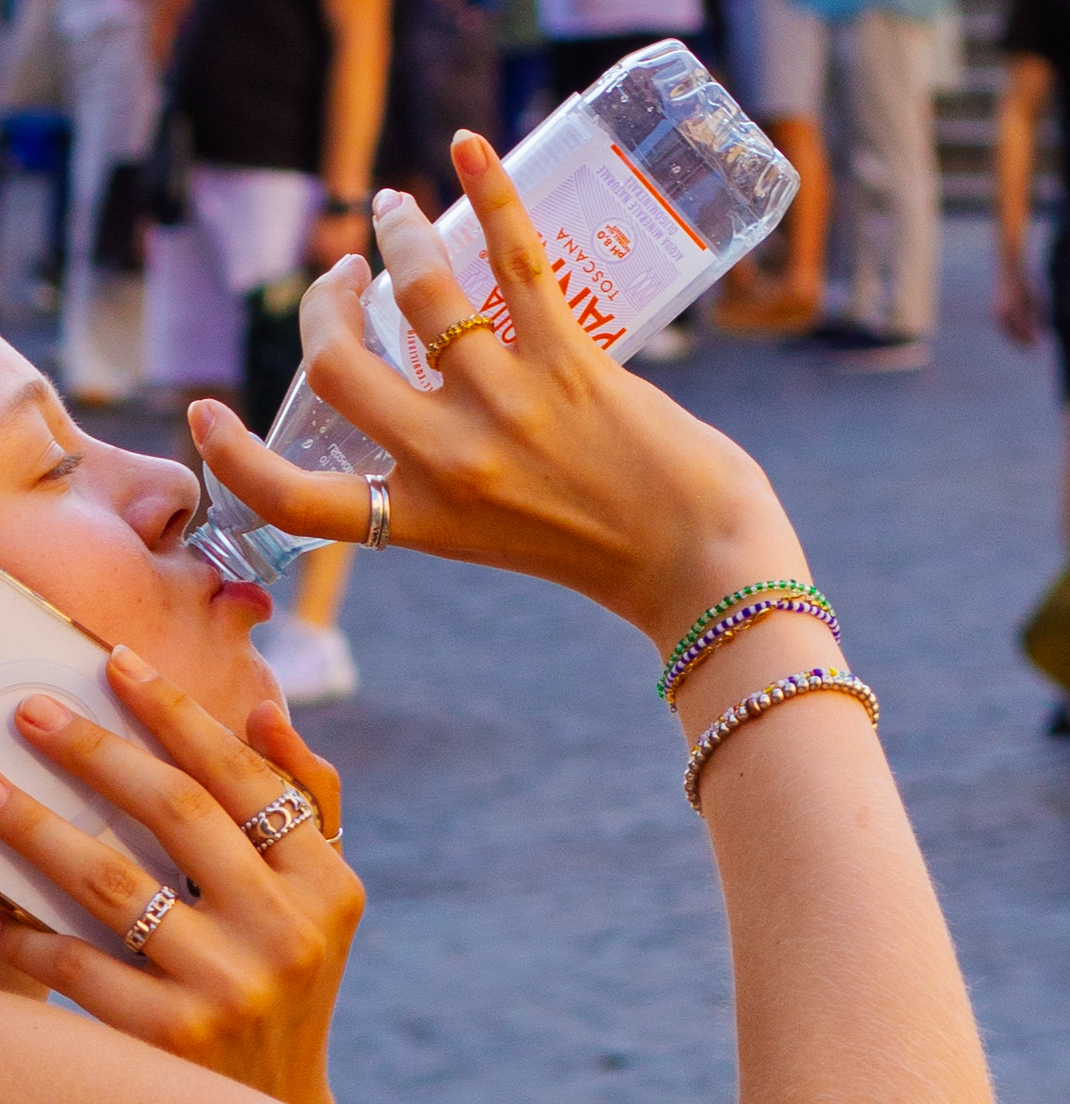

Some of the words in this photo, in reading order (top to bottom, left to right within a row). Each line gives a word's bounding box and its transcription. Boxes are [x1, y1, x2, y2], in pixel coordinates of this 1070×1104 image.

[596, 165, 631, 204] NATURALE
[624, 176, 679, 236] OLIGOMINERALE
[628, 202, 664, 239] MINERALE
[556, 227, 620, 301] TOSCANA
[661, 237, 685, 261] ACQUA
